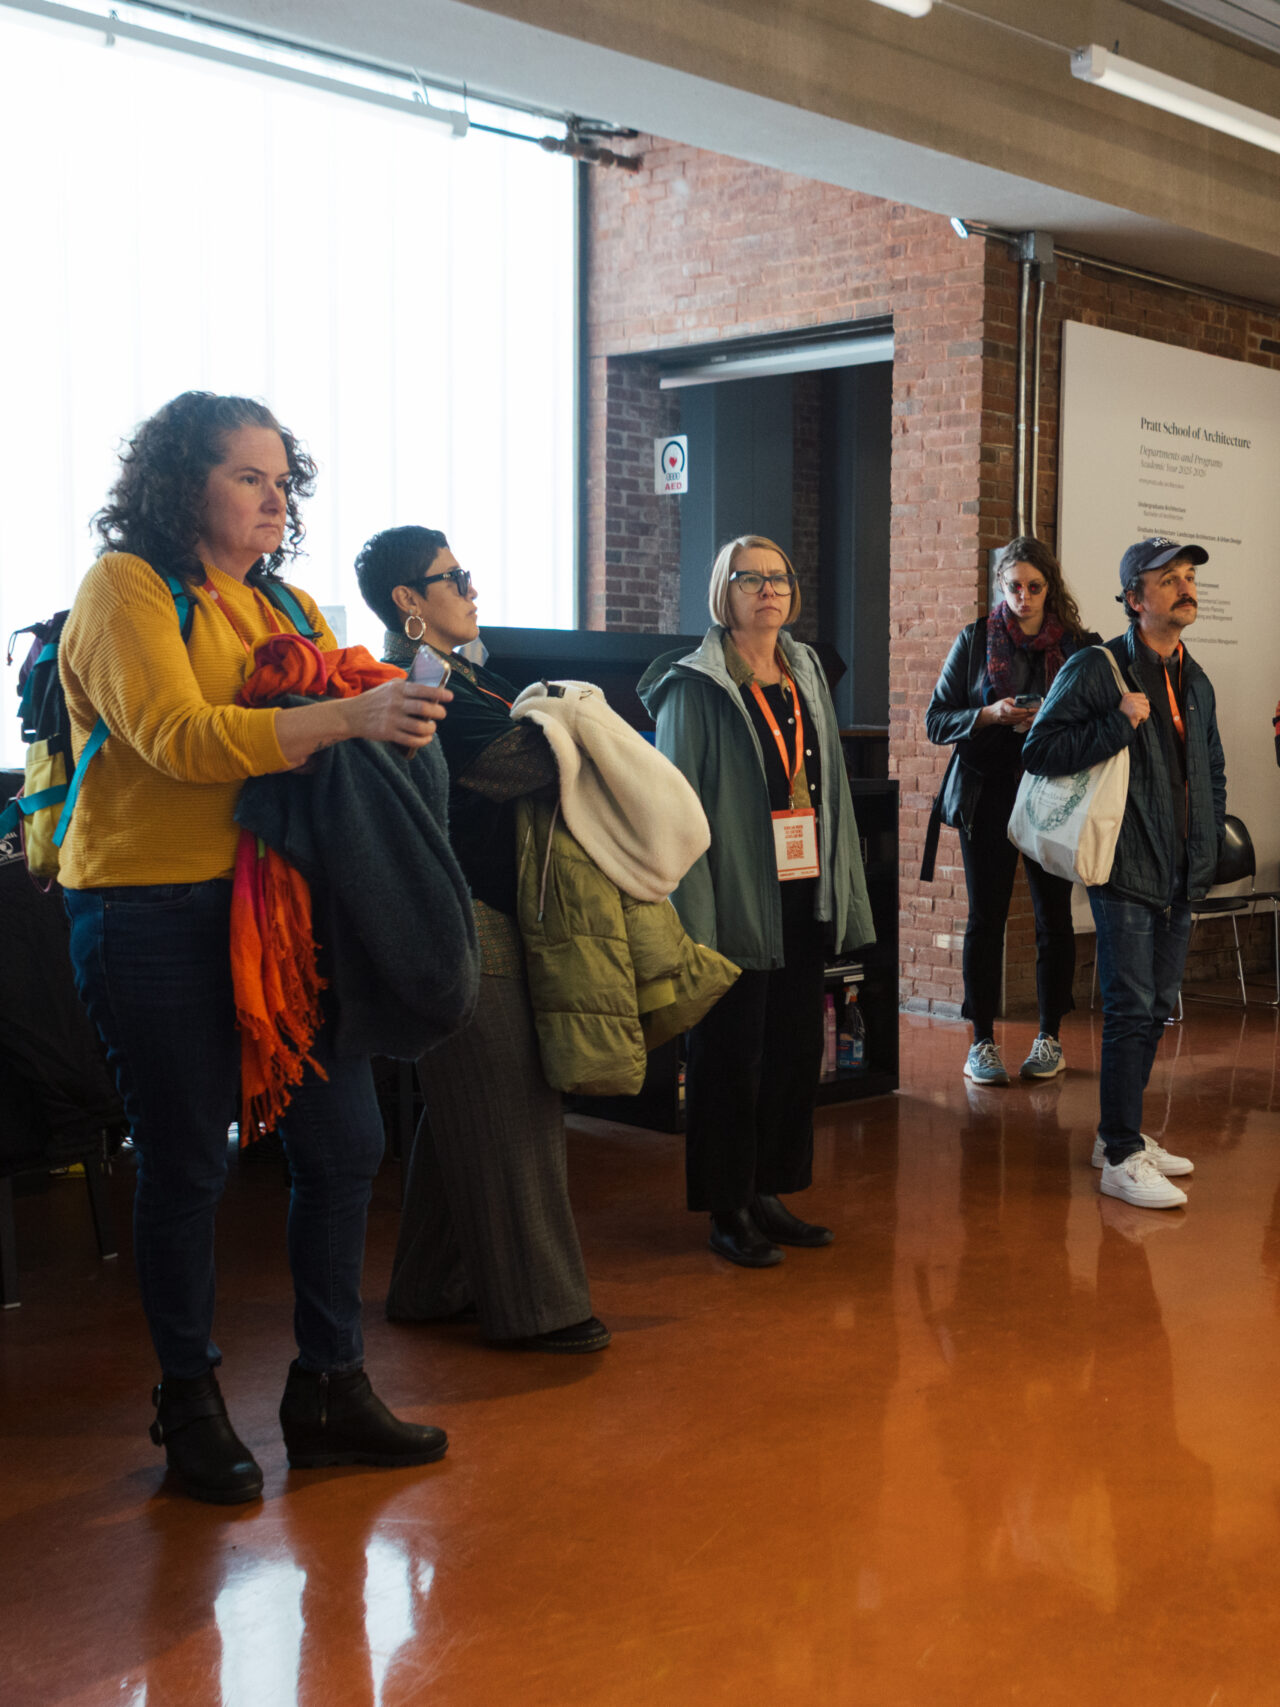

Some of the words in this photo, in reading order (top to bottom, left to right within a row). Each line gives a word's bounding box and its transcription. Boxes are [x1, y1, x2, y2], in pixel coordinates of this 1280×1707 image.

[1140, 417, 1161, 433] Pratt
[1163, 422, 1191, 439] School
[1192, 426, 1201, 440] of
[1202, 429, 1252, 449] Architecture
[1139, 444, 1180, 461] Departments
[1180, 452, 1194, 464] and
[1194, 454, 1224, 469] Programs
[665, 482, 682, 490] AED
